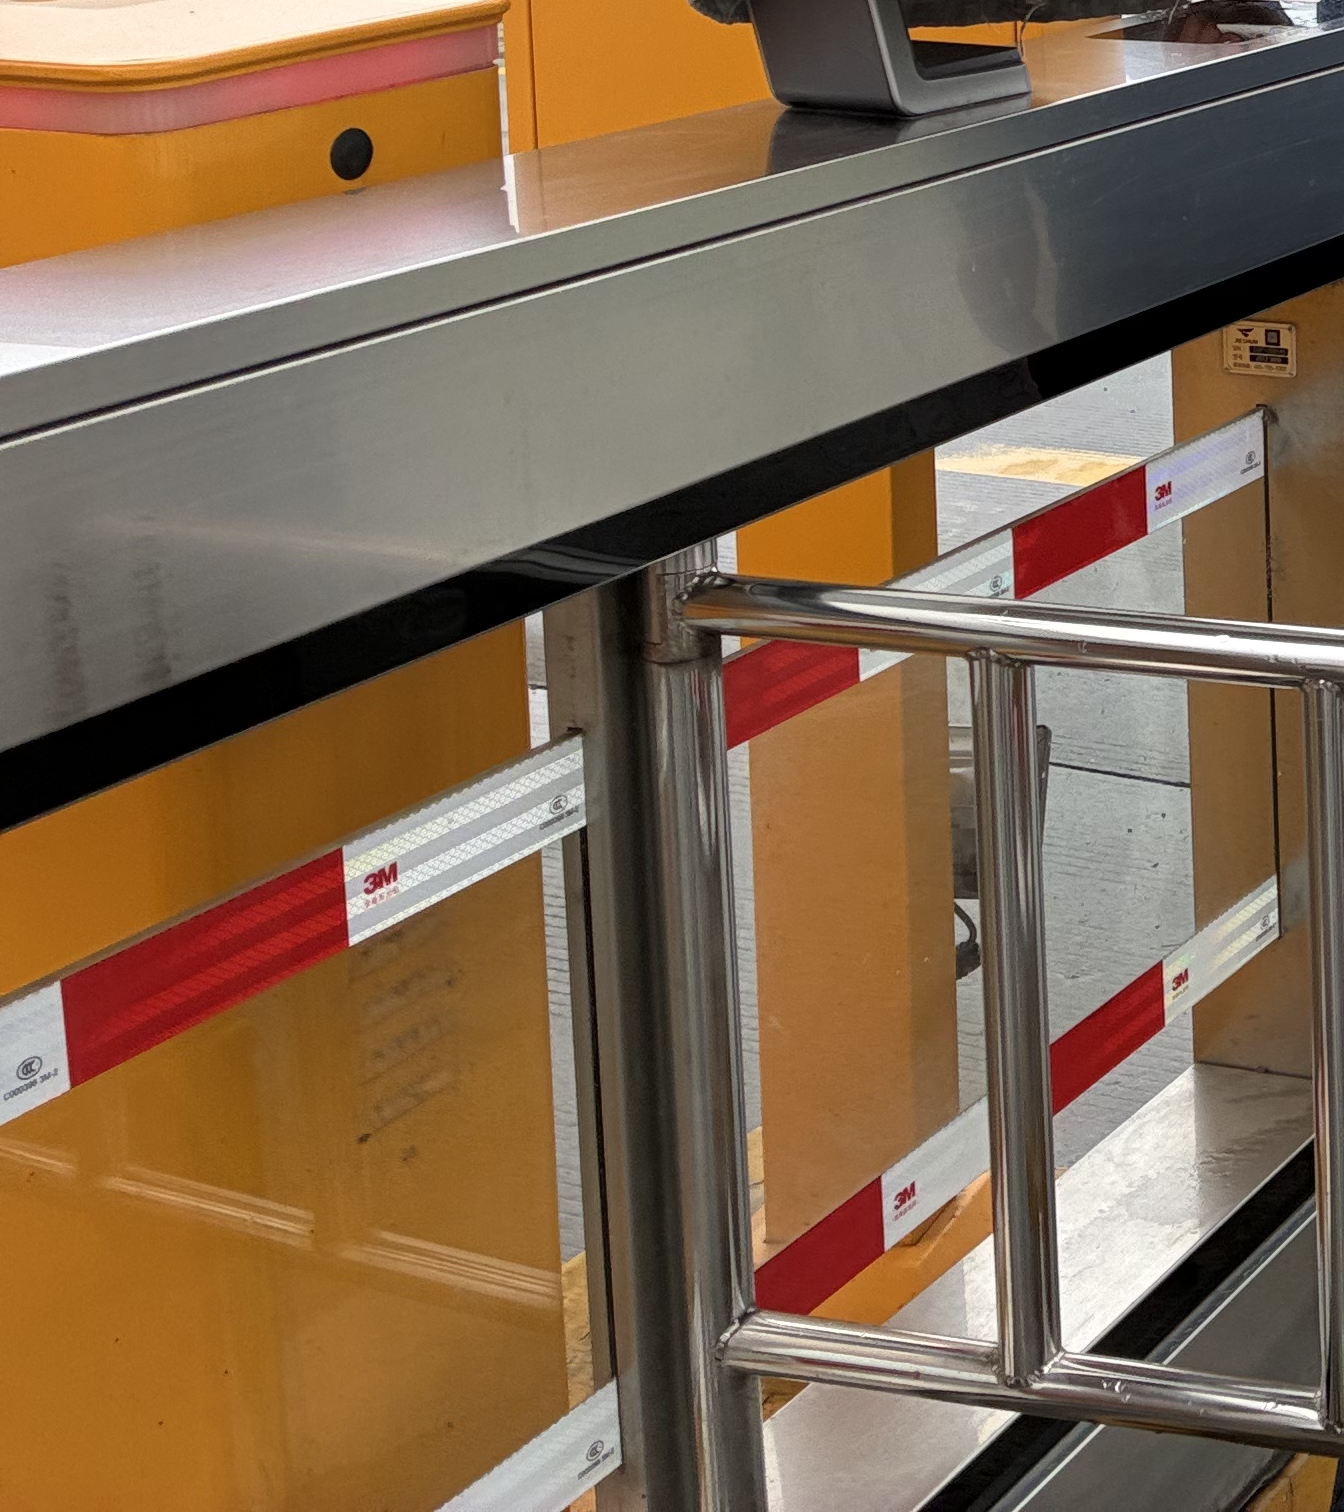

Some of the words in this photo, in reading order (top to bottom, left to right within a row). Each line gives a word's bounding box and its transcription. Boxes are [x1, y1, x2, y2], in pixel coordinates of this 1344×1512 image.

[1155, 481, 1172, 501] 3M
[364, 861, 398, 895] 3M
[1172, 968, 1189, 991] 3M
[894, 1181, 916, 1210] 3M
